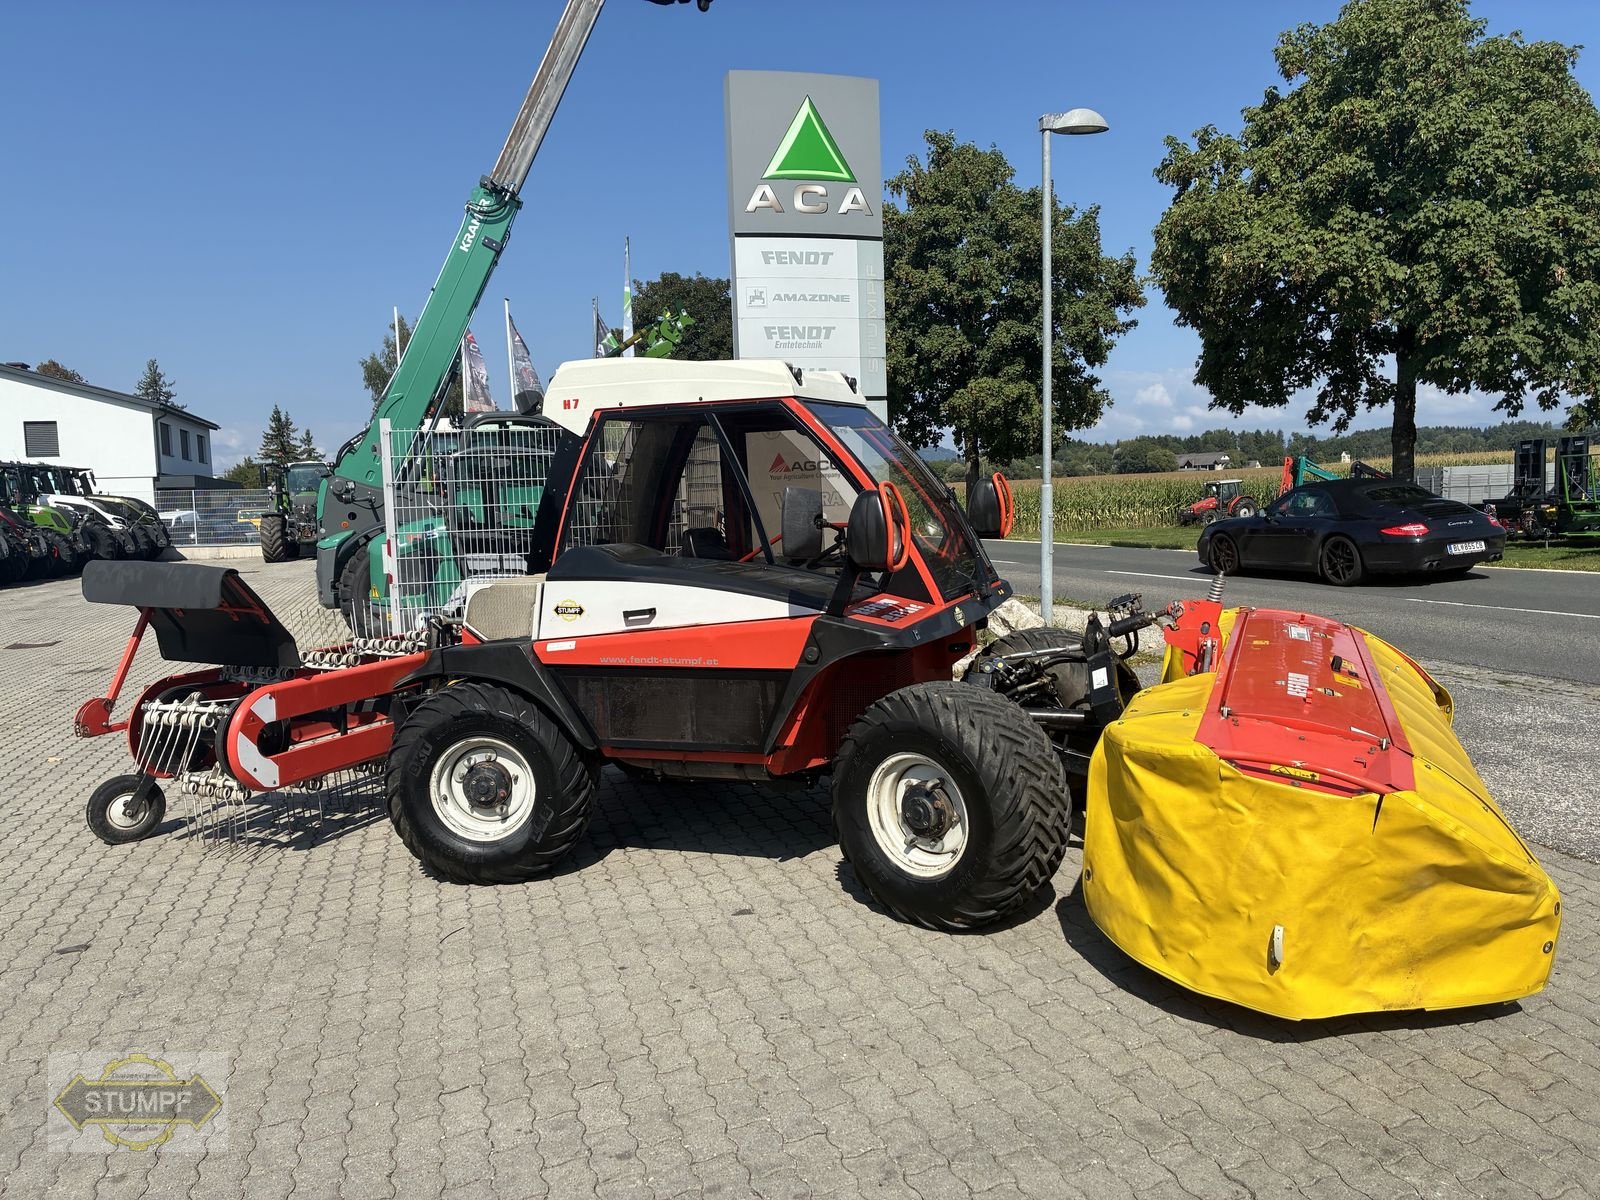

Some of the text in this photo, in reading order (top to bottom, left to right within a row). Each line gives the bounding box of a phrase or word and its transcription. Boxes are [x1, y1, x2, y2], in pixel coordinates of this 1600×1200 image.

[745, 184, 873, 216] ACA
[761, 251, 834, 265] FENDT
[772, 293, 850, 303] AMAZONE
[866, 263, 879, 374] STUMPF
[763, 326, 836, 340] FENDT
[774, 341, 823, 349] Erntetechnik
[784, 472, 814, 480] Agriculture
[816, 471, 841, 480] Company
[600, 655, 718, 666] www.fendt-stumpf.at
